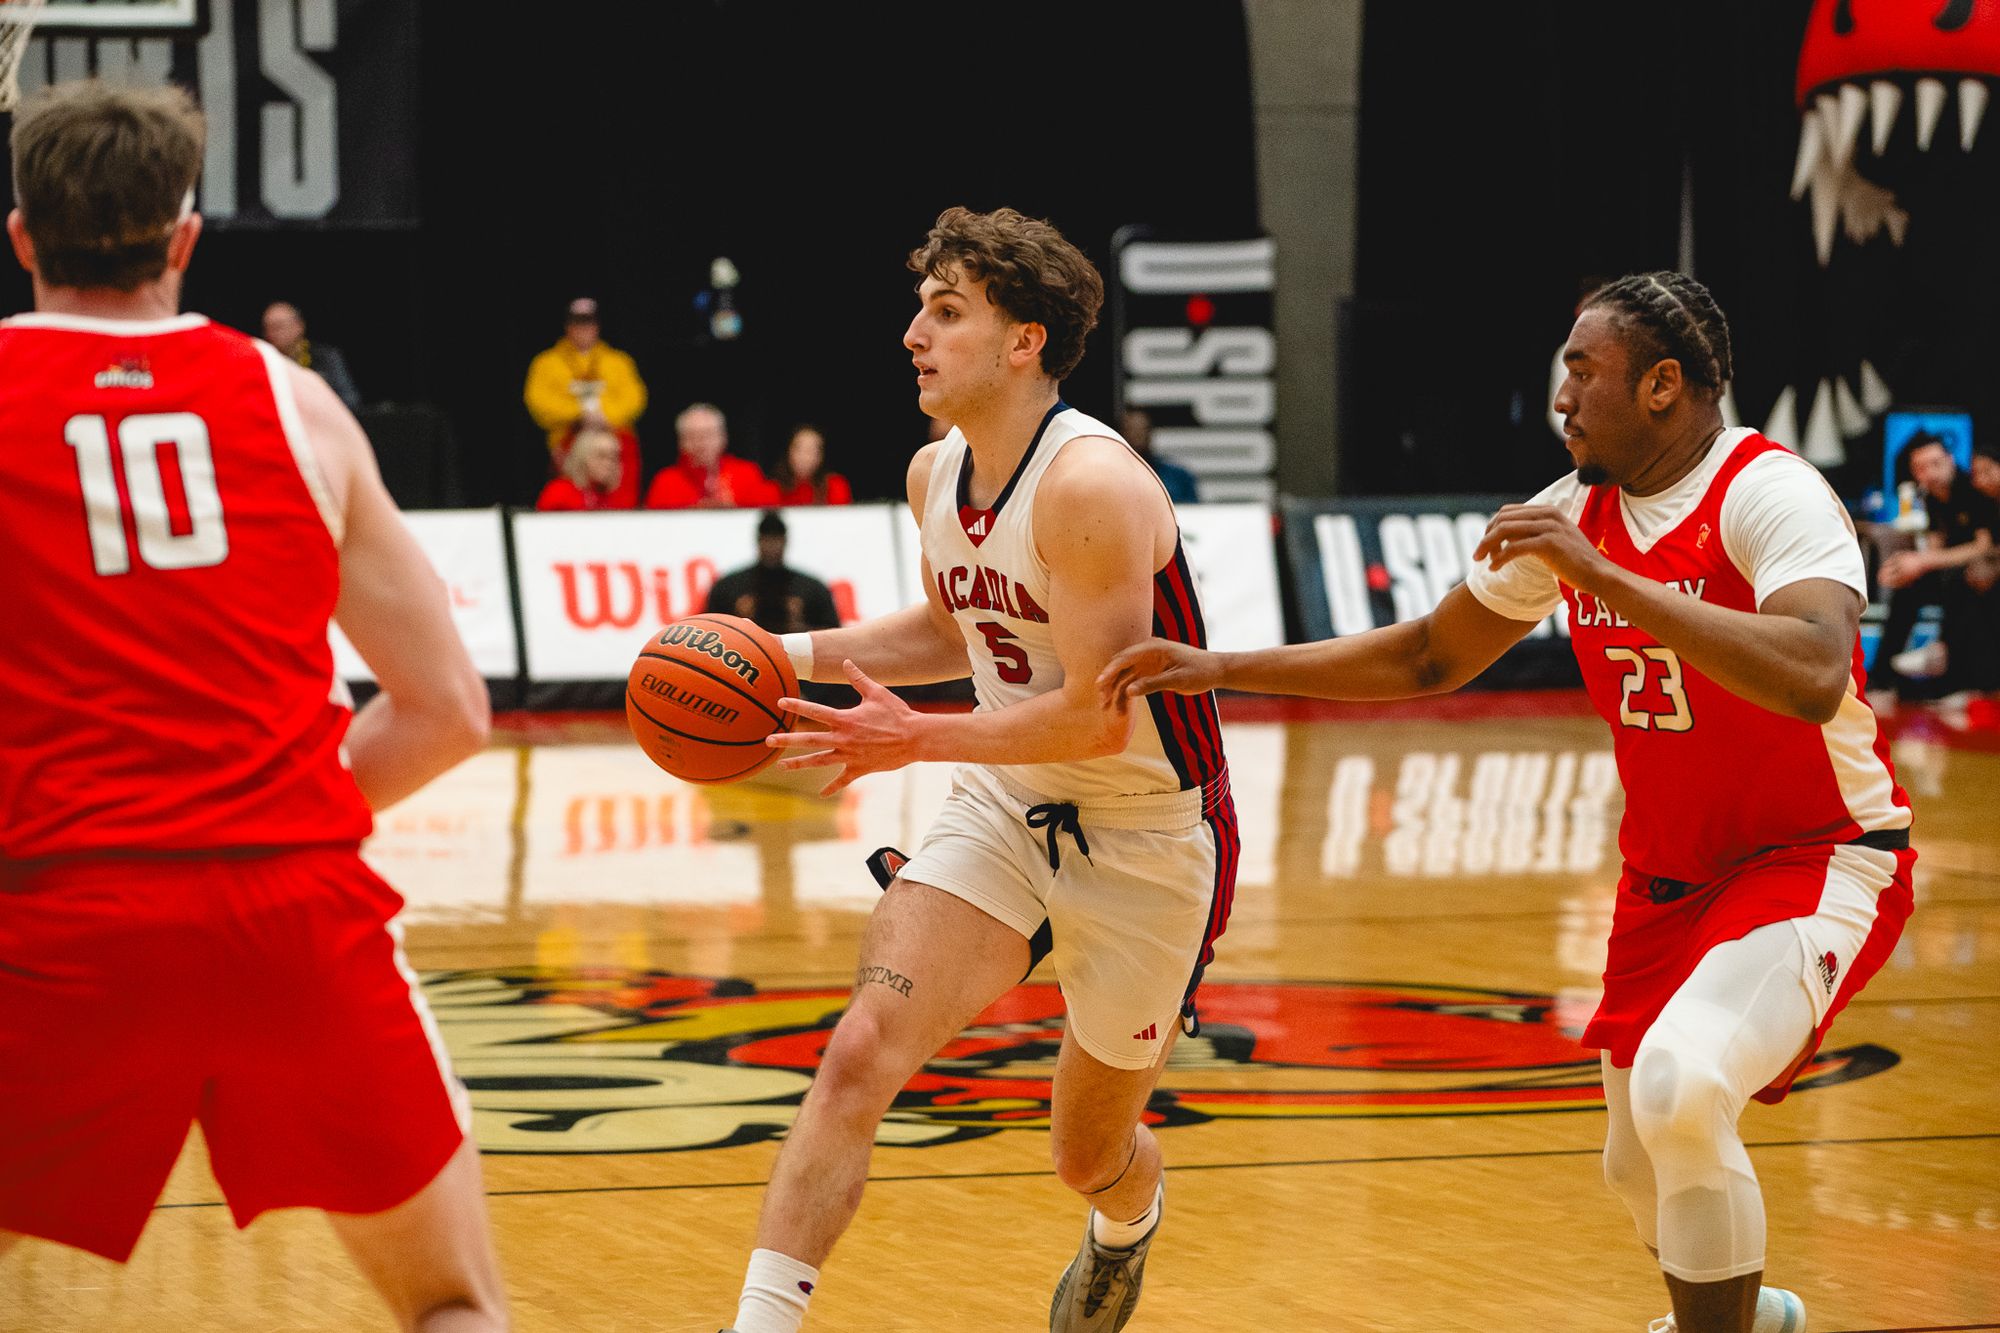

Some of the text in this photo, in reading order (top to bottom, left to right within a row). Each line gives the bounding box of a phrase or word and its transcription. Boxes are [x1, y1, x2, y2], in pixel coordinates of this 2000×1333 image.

[65, 412, 229, 576] 10
[938, 564, 1050, 624] ACADIA
[1313, 513, 1375, 636] U
[658, 624, 760, 687] Wilson
[975, 621, 1033, 684] 5
[640, 673, 740, 724] EVOLUTION
[1604, 645, 1695, 732] 23
